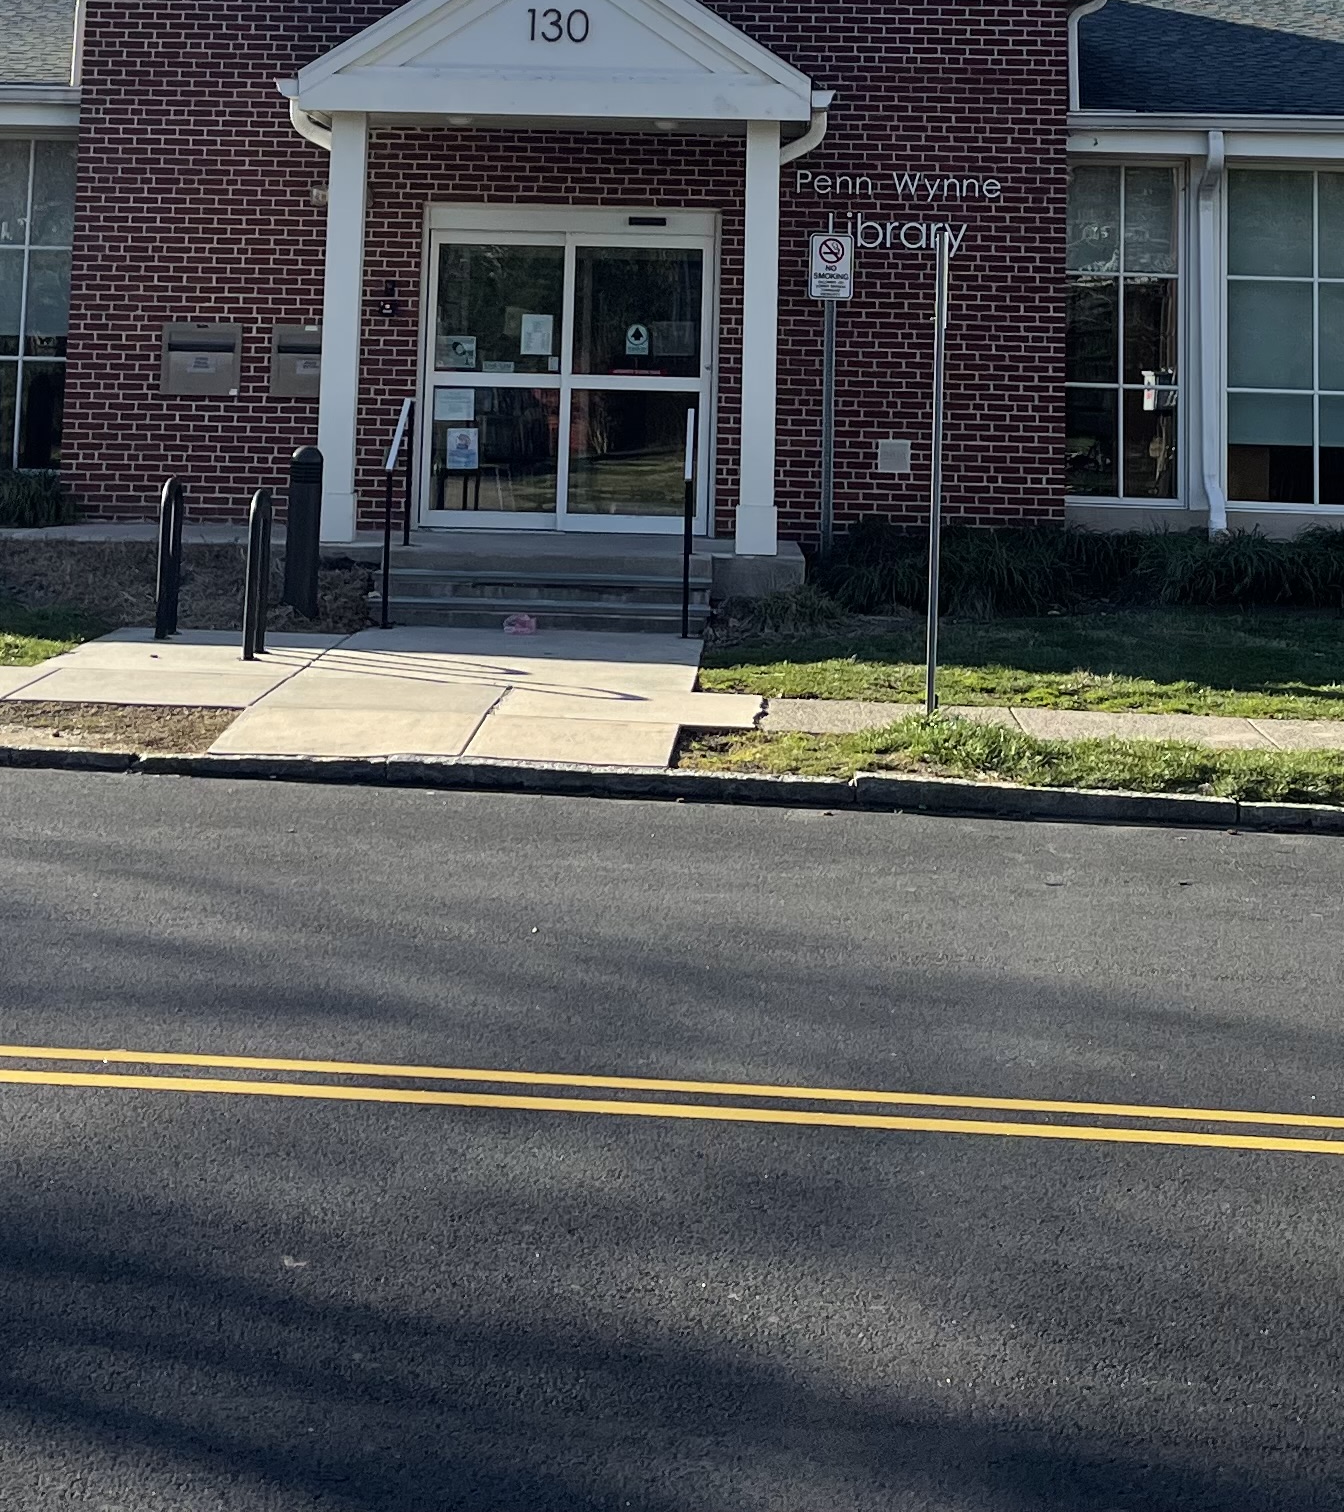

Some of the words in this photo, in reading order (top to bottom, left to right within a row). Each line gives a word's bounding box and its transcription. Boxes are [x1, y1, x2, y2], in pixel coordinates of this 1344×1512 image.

[527, 8, 590, 43] 130
[796, 169, 872, 195] Penn
[892, 171, 1002, 202] Wynne
[813, 272, 849, 280] SMOKING
